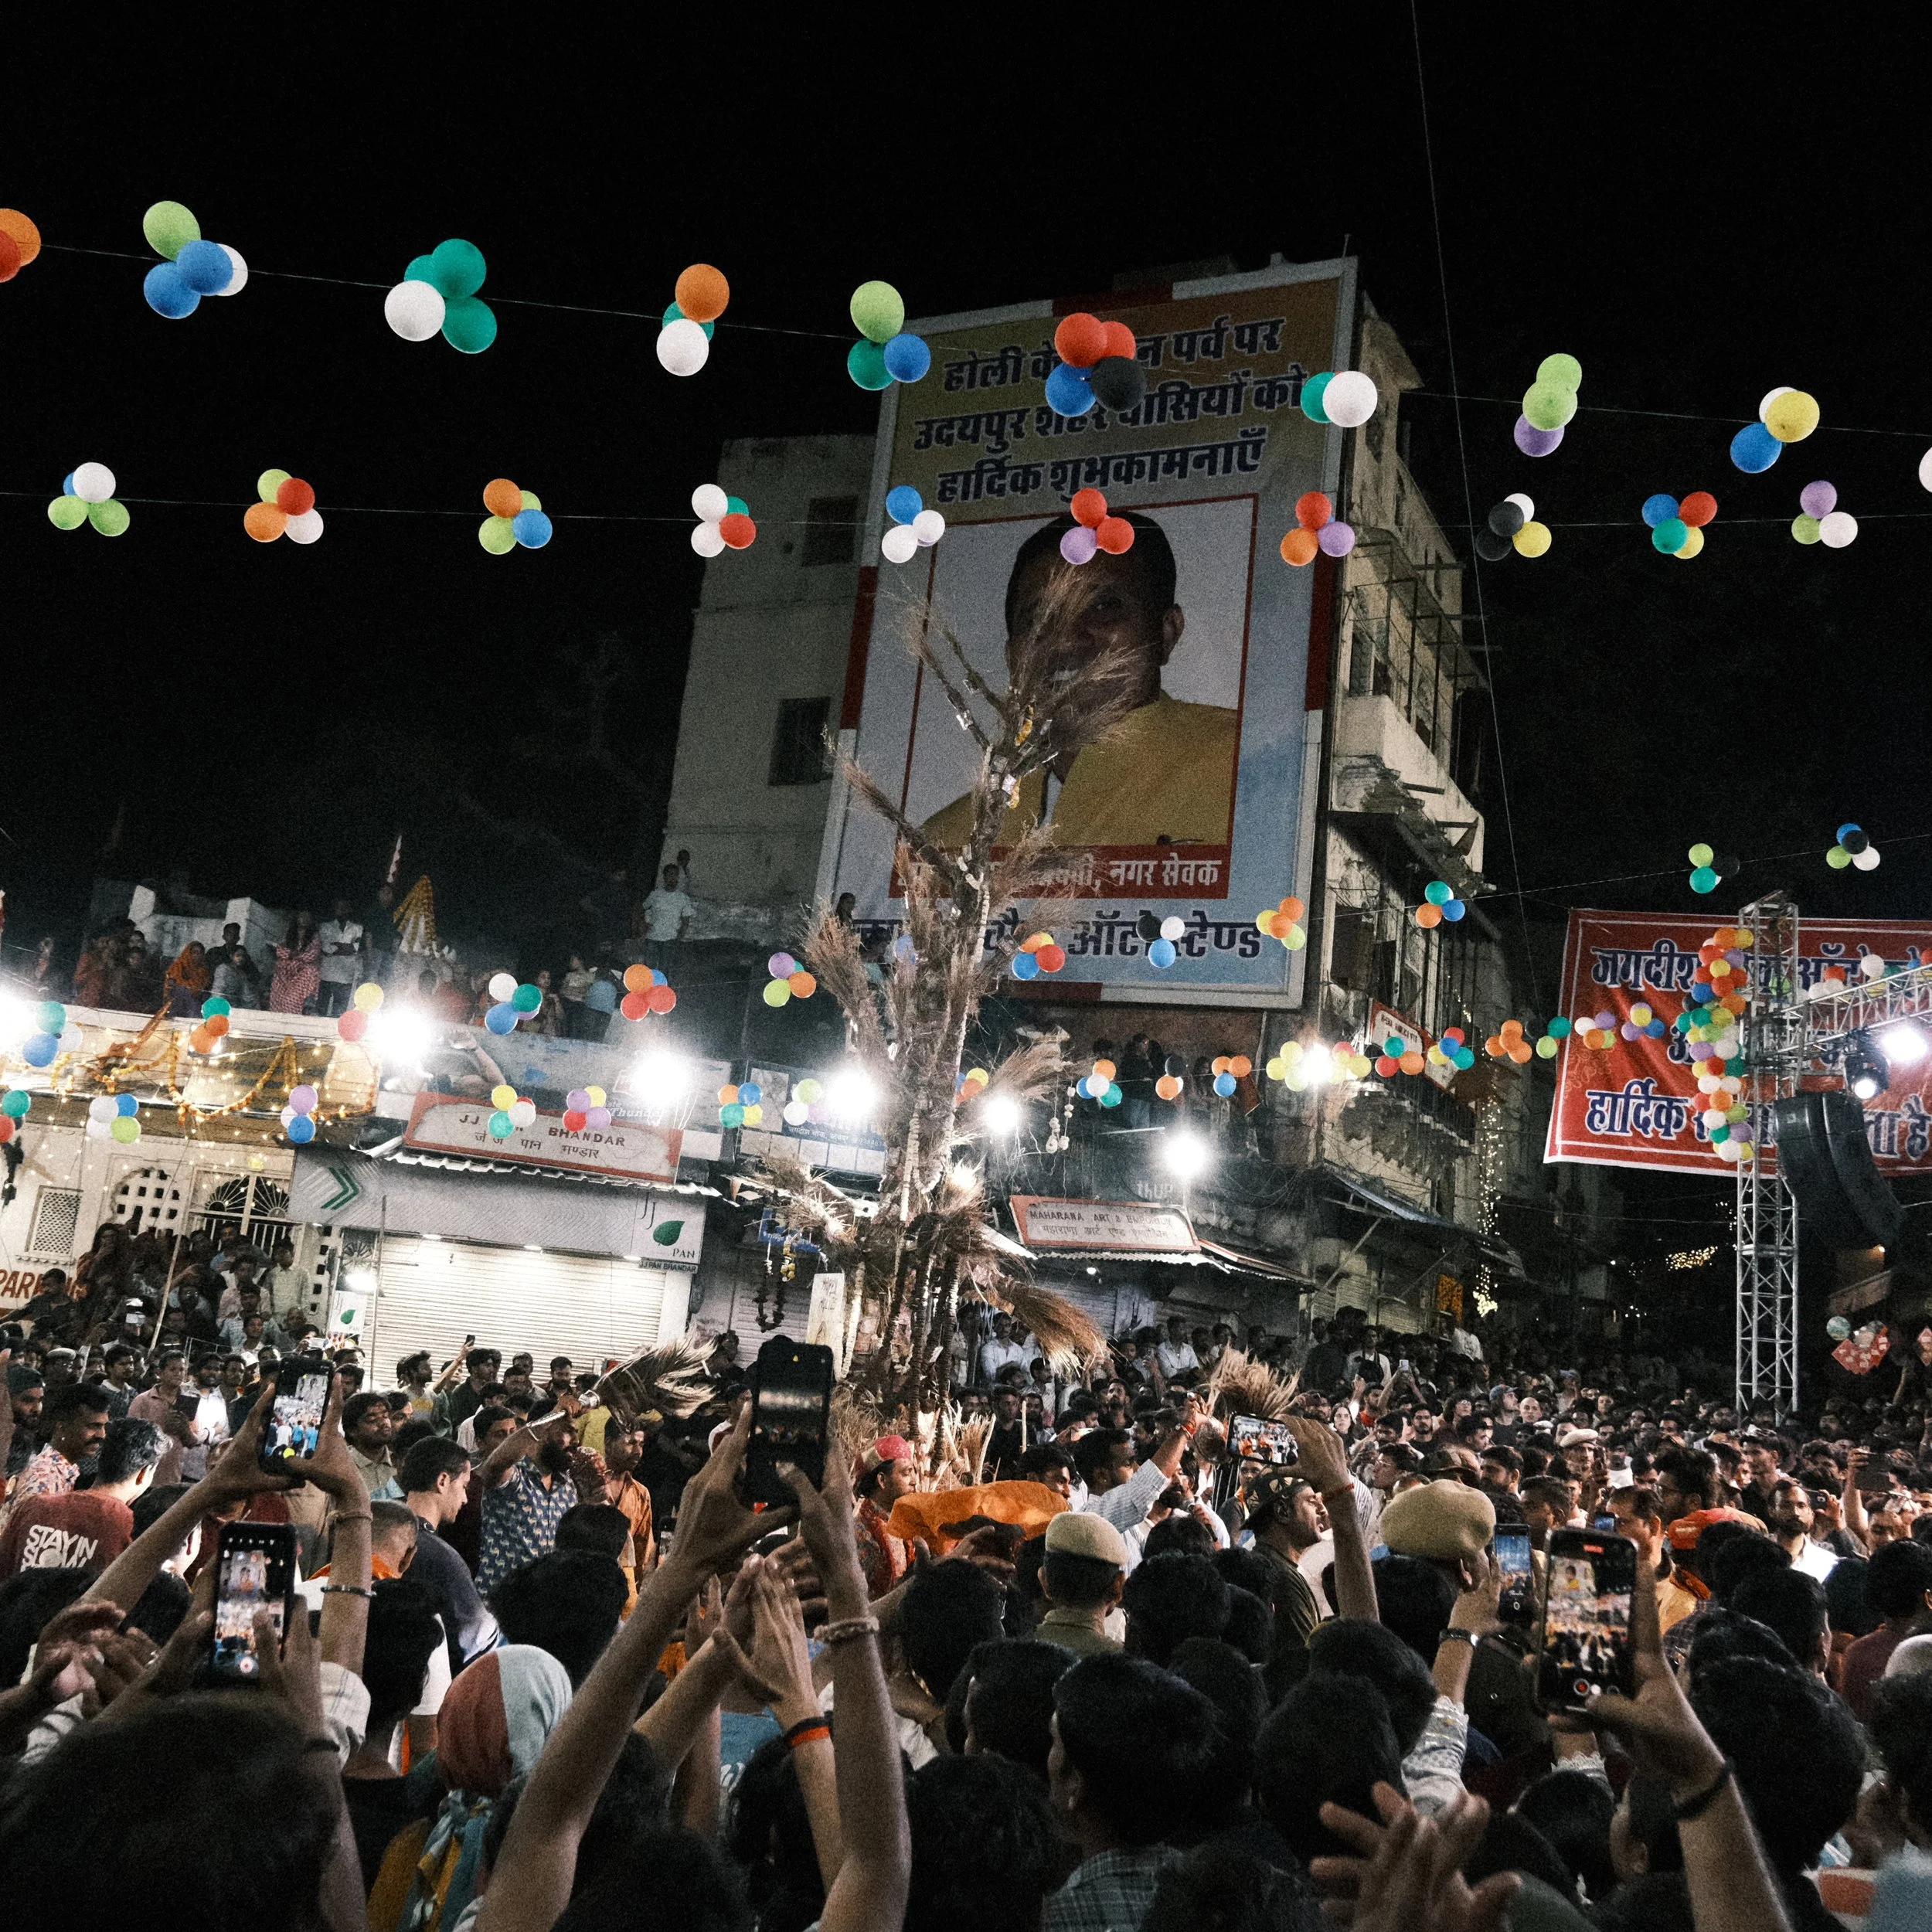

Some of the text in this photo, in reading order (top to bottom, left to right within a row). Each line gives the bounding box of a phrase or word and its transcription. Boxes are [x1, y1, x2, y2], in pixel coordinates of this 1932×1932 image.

[944, 345, 1025, 392] होली
[1171, 315, 1230, 363] पर्व
[1233, 317, 1286, 355] पर
[913, 407, 1031, 454] उदयपुर
[1252, 362, 1308, 411] को
[937, 454, 1046, 503] हार्दिक
[1108, 860, 1158, 886] नगर
[1162, 852, 1222, 886] सेवक
[1585, 1077, 1690, 1140] हार्दिक
[1902, 1094, 1932, 1160] है
[521, 1138, 542, 1151] पान
[548, 1127, 625, 1147] BHANDAR
[1029, 1210, 1084, 1222] MAHARANA
[1094, 1213, 1111, 1222] ART
[1041, 1225, 1078, 1235] महाराणा
[672, 1248, 695, 1259] PAN
[663, 1263, 696, 1274] BHANDAR
[26, 1524, 98, 1560] STAY IN
